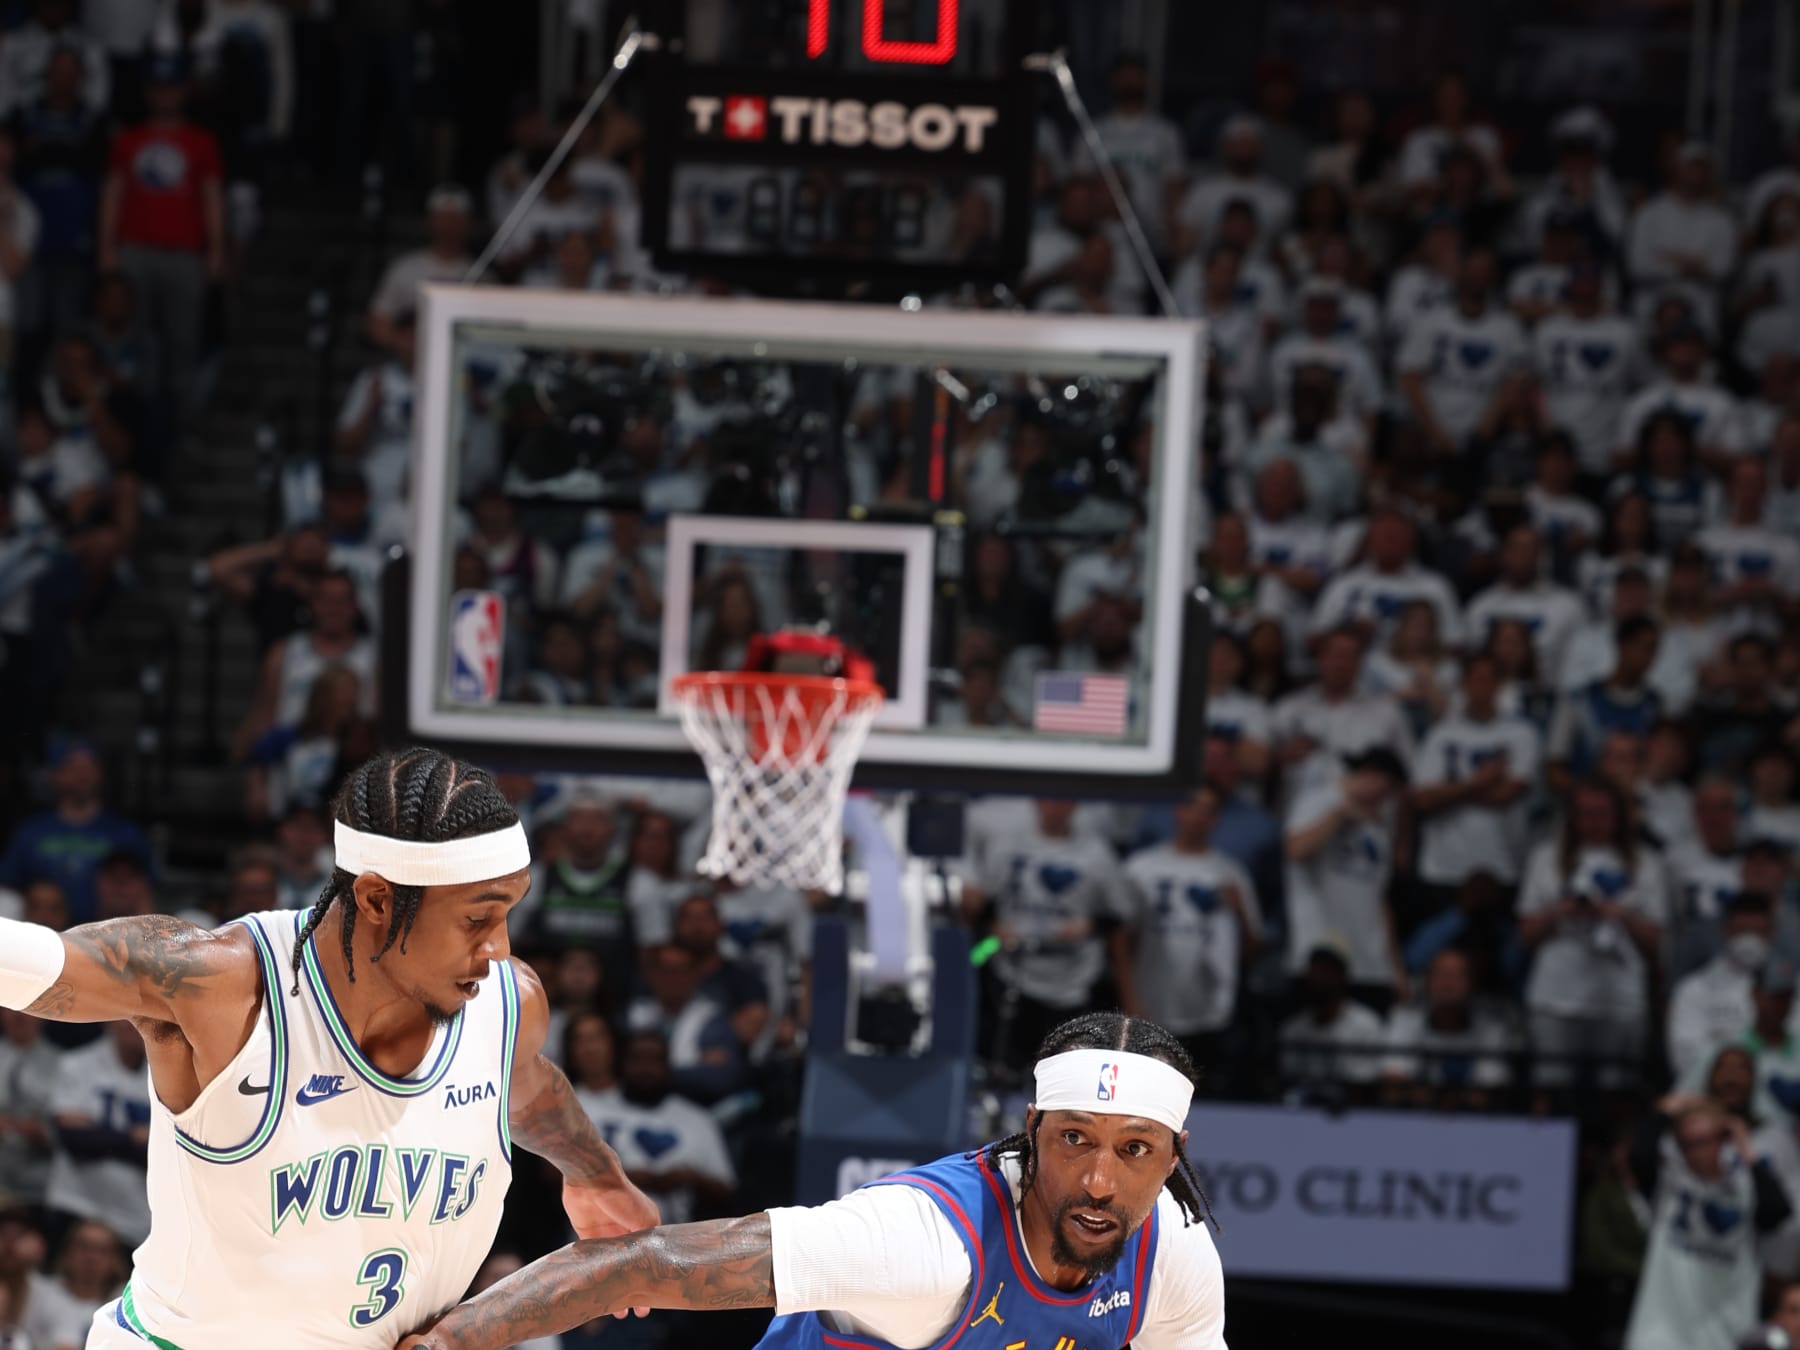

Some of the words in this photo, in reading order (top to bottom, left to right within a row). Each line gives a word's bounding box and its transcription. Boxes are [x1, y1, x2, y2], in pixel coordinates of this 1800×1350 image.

[771, 96, 998, 154] TISSOT
[308, 1074, 345, 1093] NIKE
[271, 1143, 488, 1236] WOLVES
[1197, 1161, 1280, 1214] YO
[1296, 1164, 1521, 1225] CLINIC
[350, 1247, 409, 1329] 3
